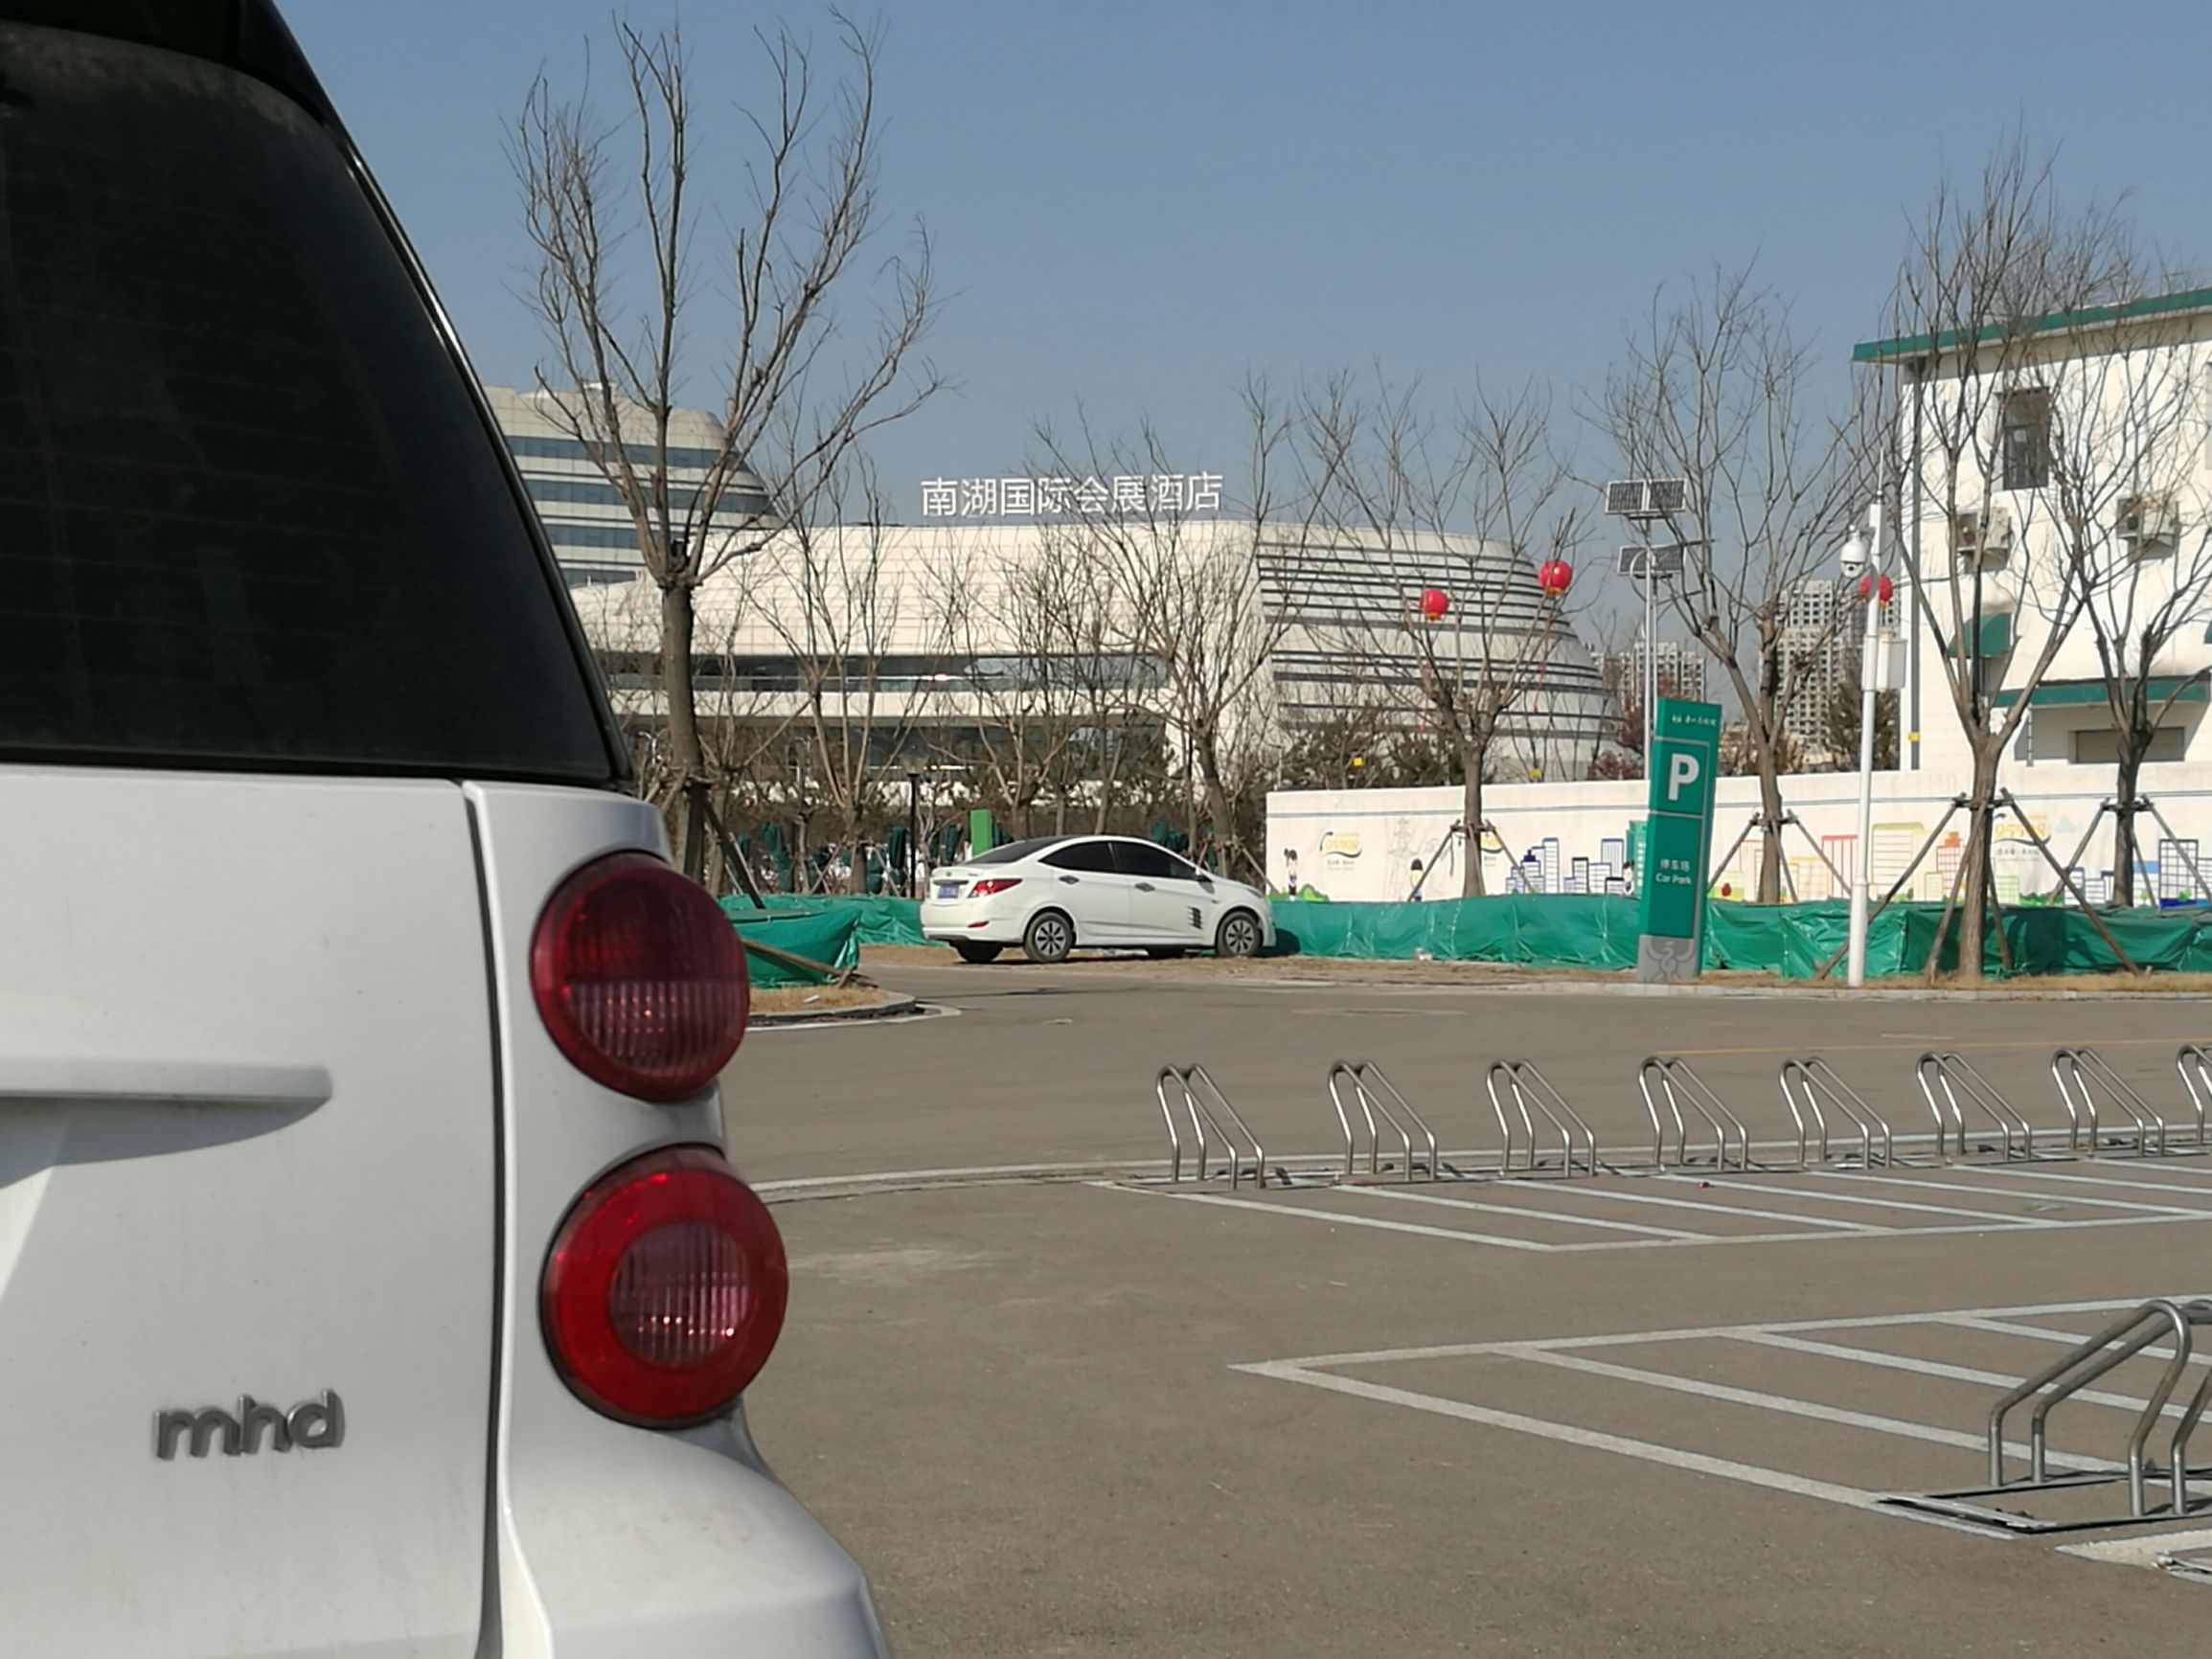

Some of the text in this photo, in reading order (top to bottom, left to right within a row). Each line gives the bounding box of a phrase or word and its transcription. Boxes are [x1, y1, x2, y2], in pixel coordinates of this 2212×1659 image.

[920, 472, 1223, 518] 南湖国际会展酒店
[1668, 752, 1699, 801] P
[1655, 873, 1692, 885] Car Park
[152, 1388, 346, 1462] mhd
